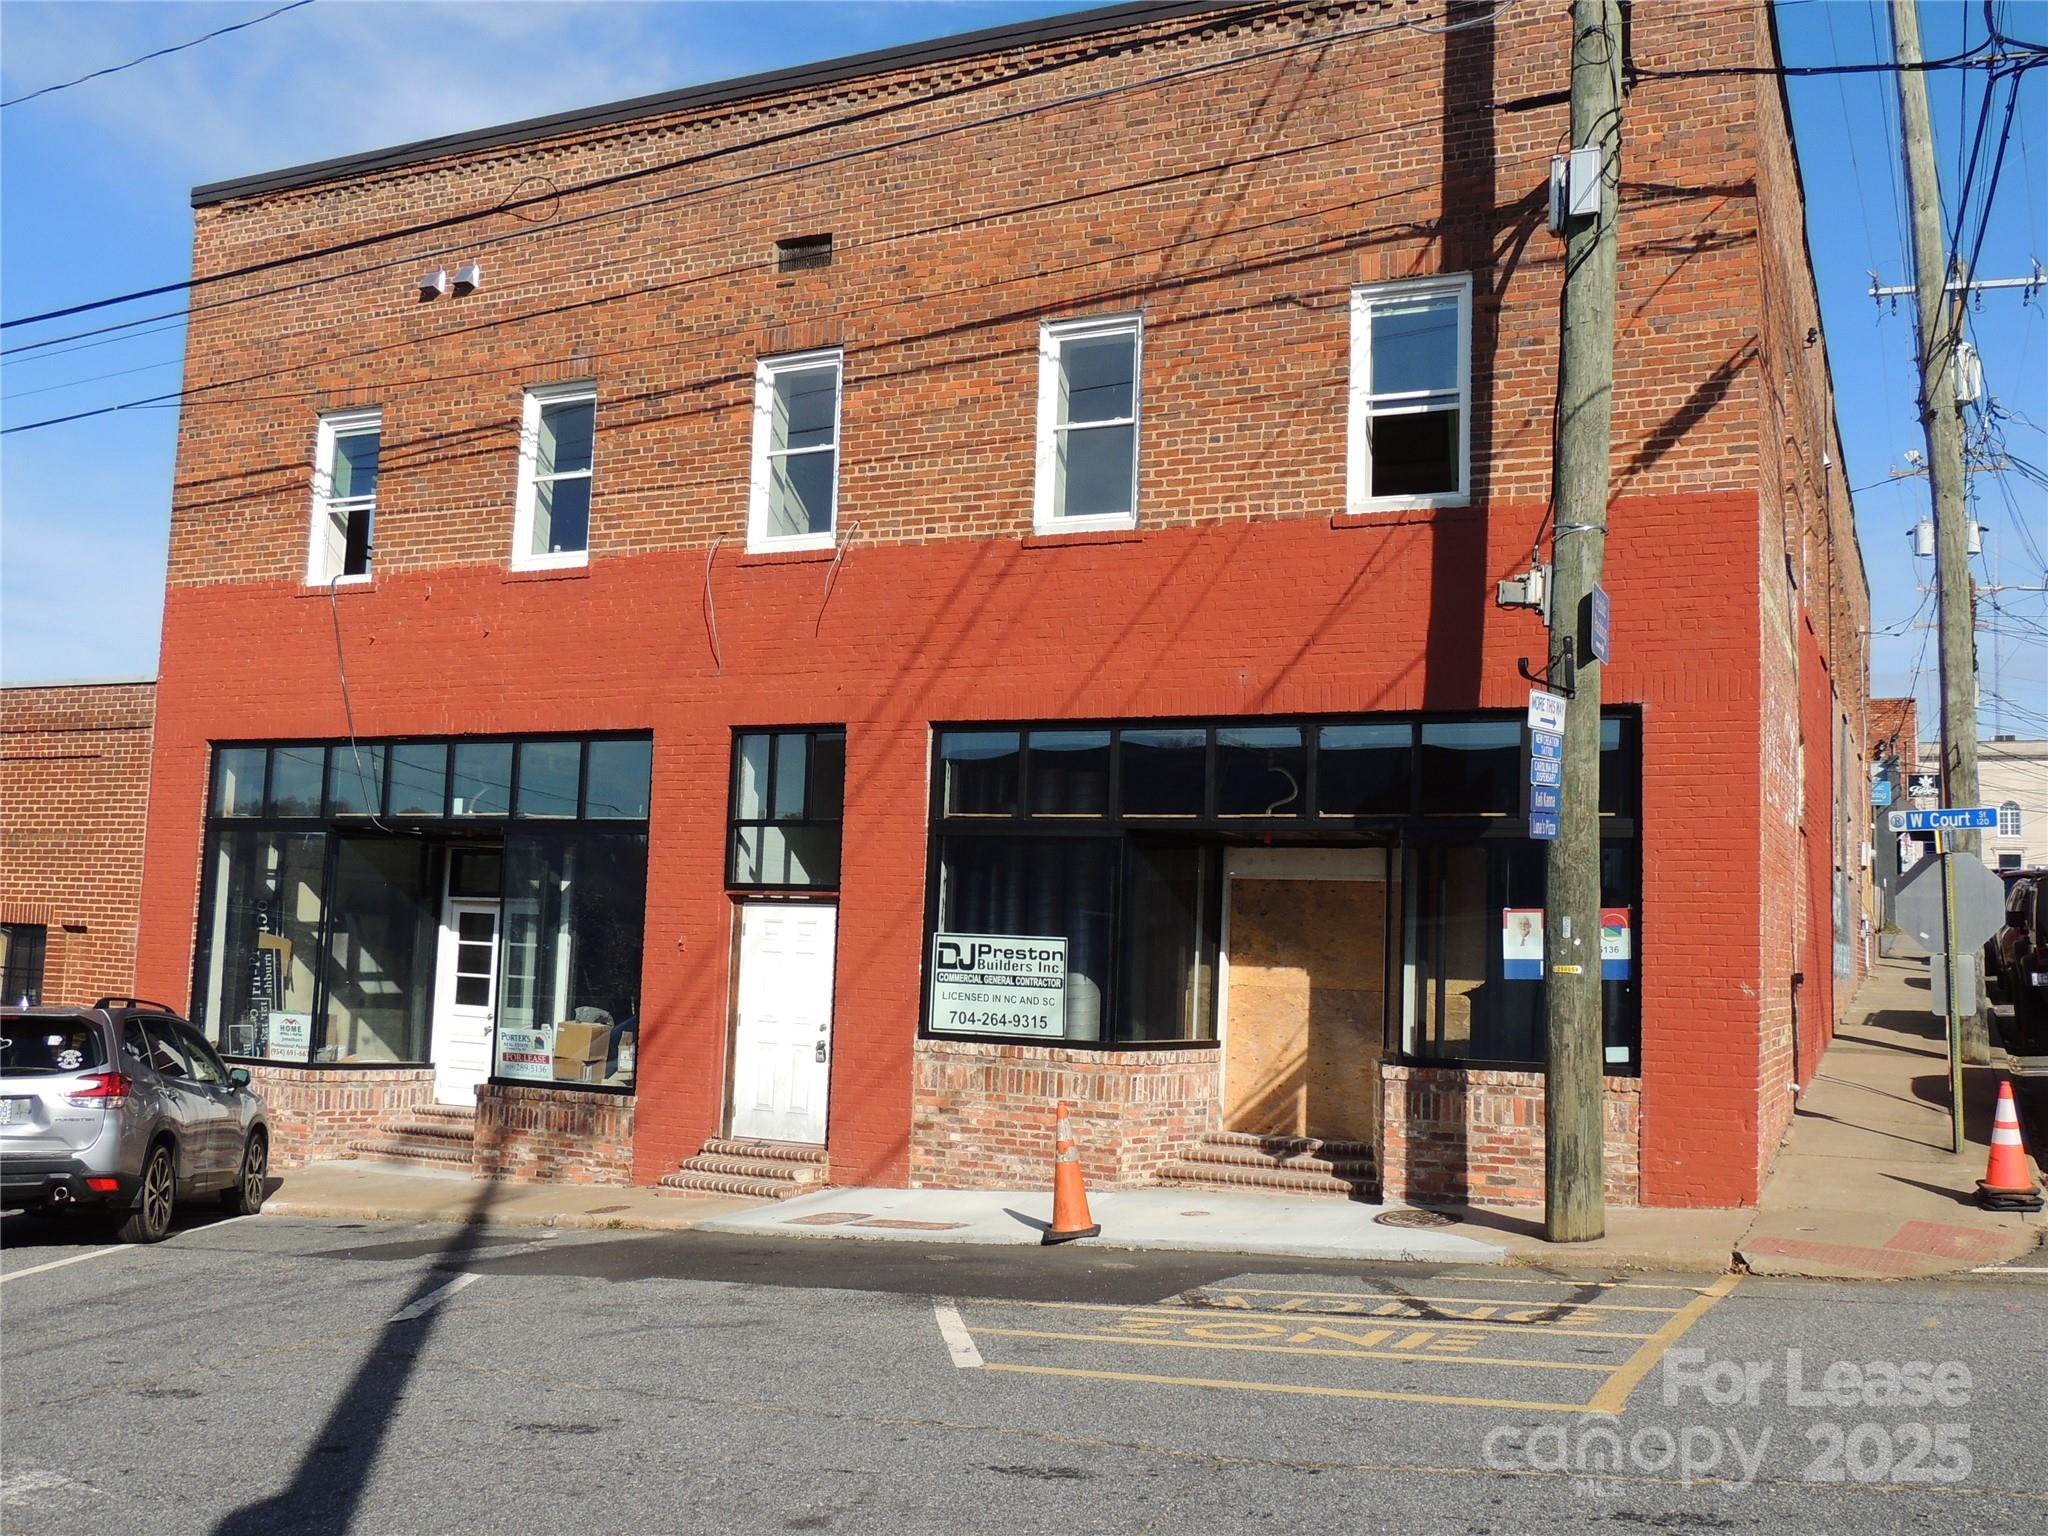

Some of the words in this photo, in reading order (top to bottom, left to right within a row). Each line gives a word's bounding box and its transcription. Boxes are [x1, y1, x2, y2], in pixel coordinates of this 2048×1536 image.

[1532, 695, 1546, 712] MORE
[1546, 698, 1556, 714] THIS
[1910, 814, 1923, 828] W
[1929, 812, 1971, 828] Court
[1976, 818, 1989, 826] 120
[937, 942, 976, 971] DJ
[978, 944, 1063, 962] Preston
[977, 959, 1032, 973] Builders
[1038, 961, 1063, 974] Inc.
[938, 973, 983, 985] COMMERCIAL
[984, 975, 1015, 986] GENERAL
[1015, 976, 1062, 988] CONTRACTOR
[942, 991, 990, 1003] LICENSED
[992, 993, 1001, 1003] IN
[1004, 994, 1017, 1004] NC
[1019, 995, 1040, 1006] AND
[1042, 996, 1056, 1007] SC
[949, 1011, 1048, 1029] 704-264-9315
[280, 1025, 302, 1033] HOME
[501, 1031, 531, 1043] PORTER'S
[505, 1053, 522, 1062] FOR
[524, 1054, 547, 1064] LEASE
[1097, 1316, 1487, 1352] ZONE
